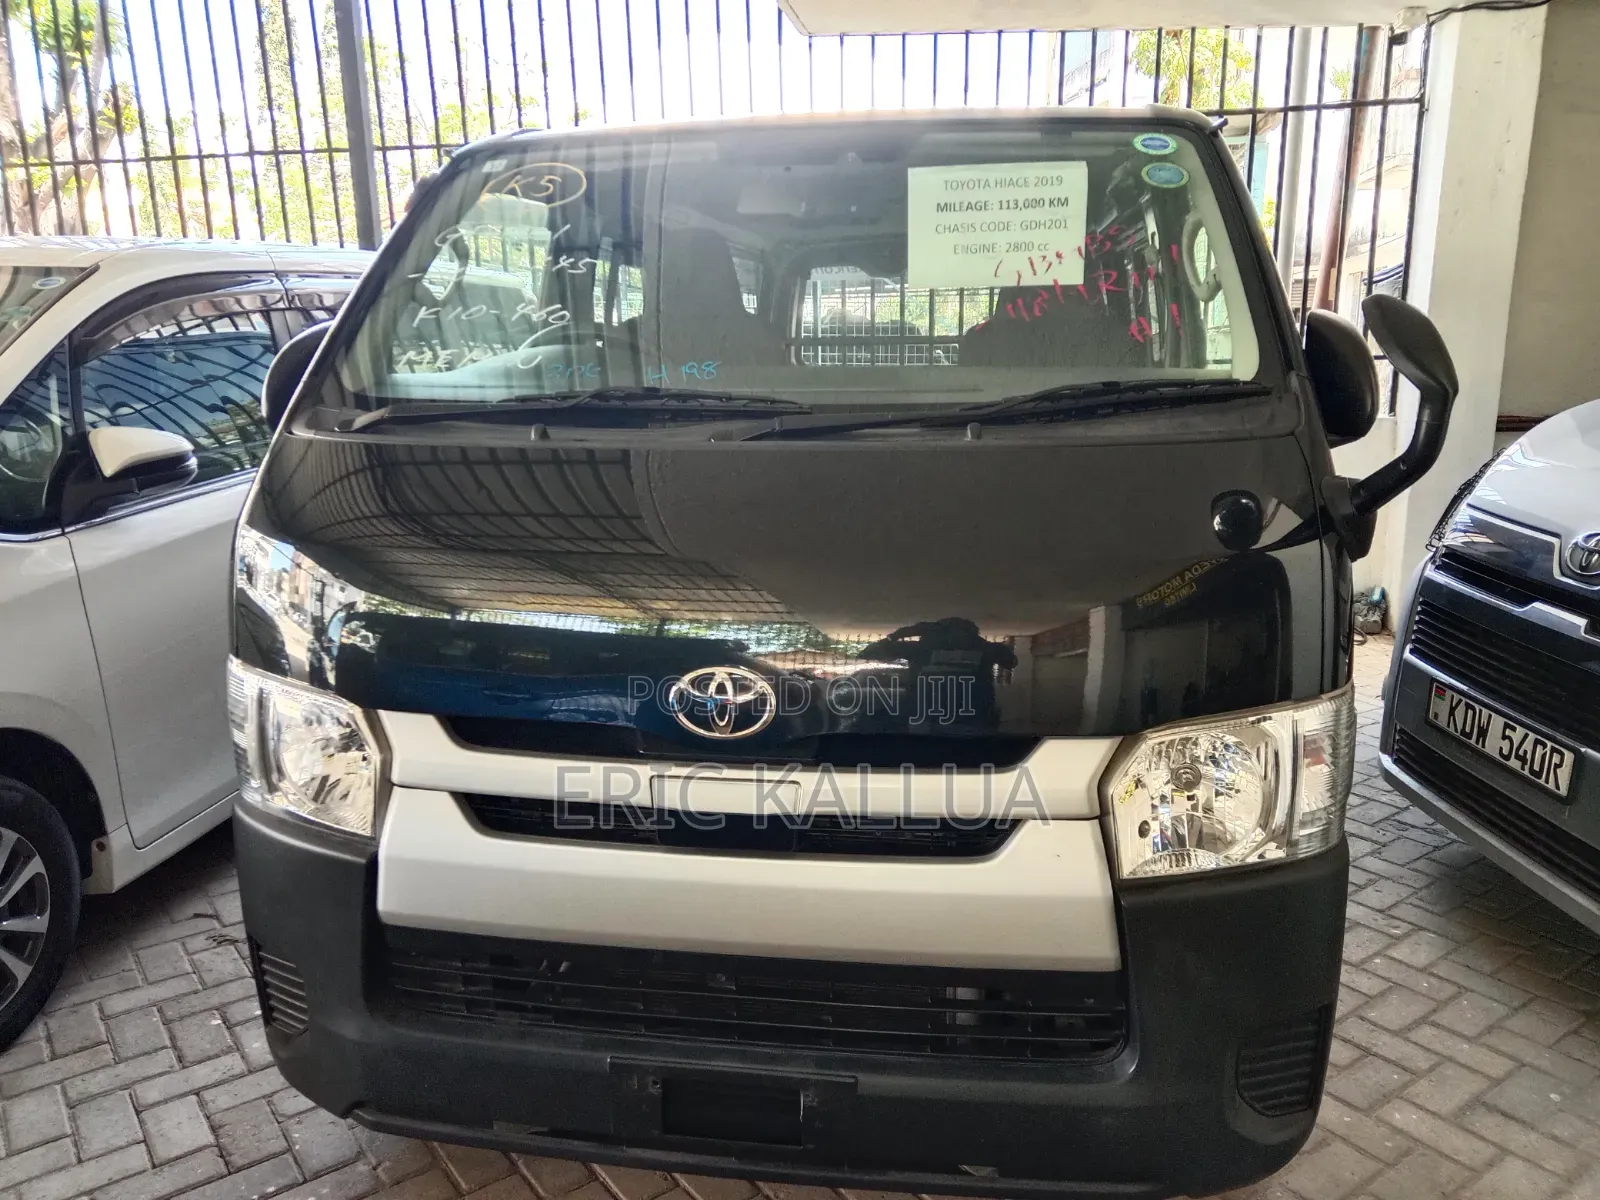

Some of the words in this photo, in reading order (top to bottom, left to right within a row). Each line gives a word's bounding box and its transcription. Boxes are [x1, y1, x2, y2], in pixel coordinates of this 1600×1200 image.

[943, 178, 991, 191] TOYOTA
[994, 176, 1030, 189] HIACE
[1034, 175, 1063, 187] 2019
[936, 200, 994, 213] MILEAGE:
[998, 199, 1045, 211] 113,000
[1048, 196, 1069, 208] KM
[935, 223, 977, 234] CHASIS
[980, 221, 1017, 233] CODE:
[1020, 219, 1068, 231] GDH201
[953, 244, 1002, 255] ENGINE:
[1005, 241, 1035, 253] 2800
[1037, 243, 1050, 252] cc
[1446, 694, 1493, 749] KDW
[1499, 721, 1566, 792] 540R
